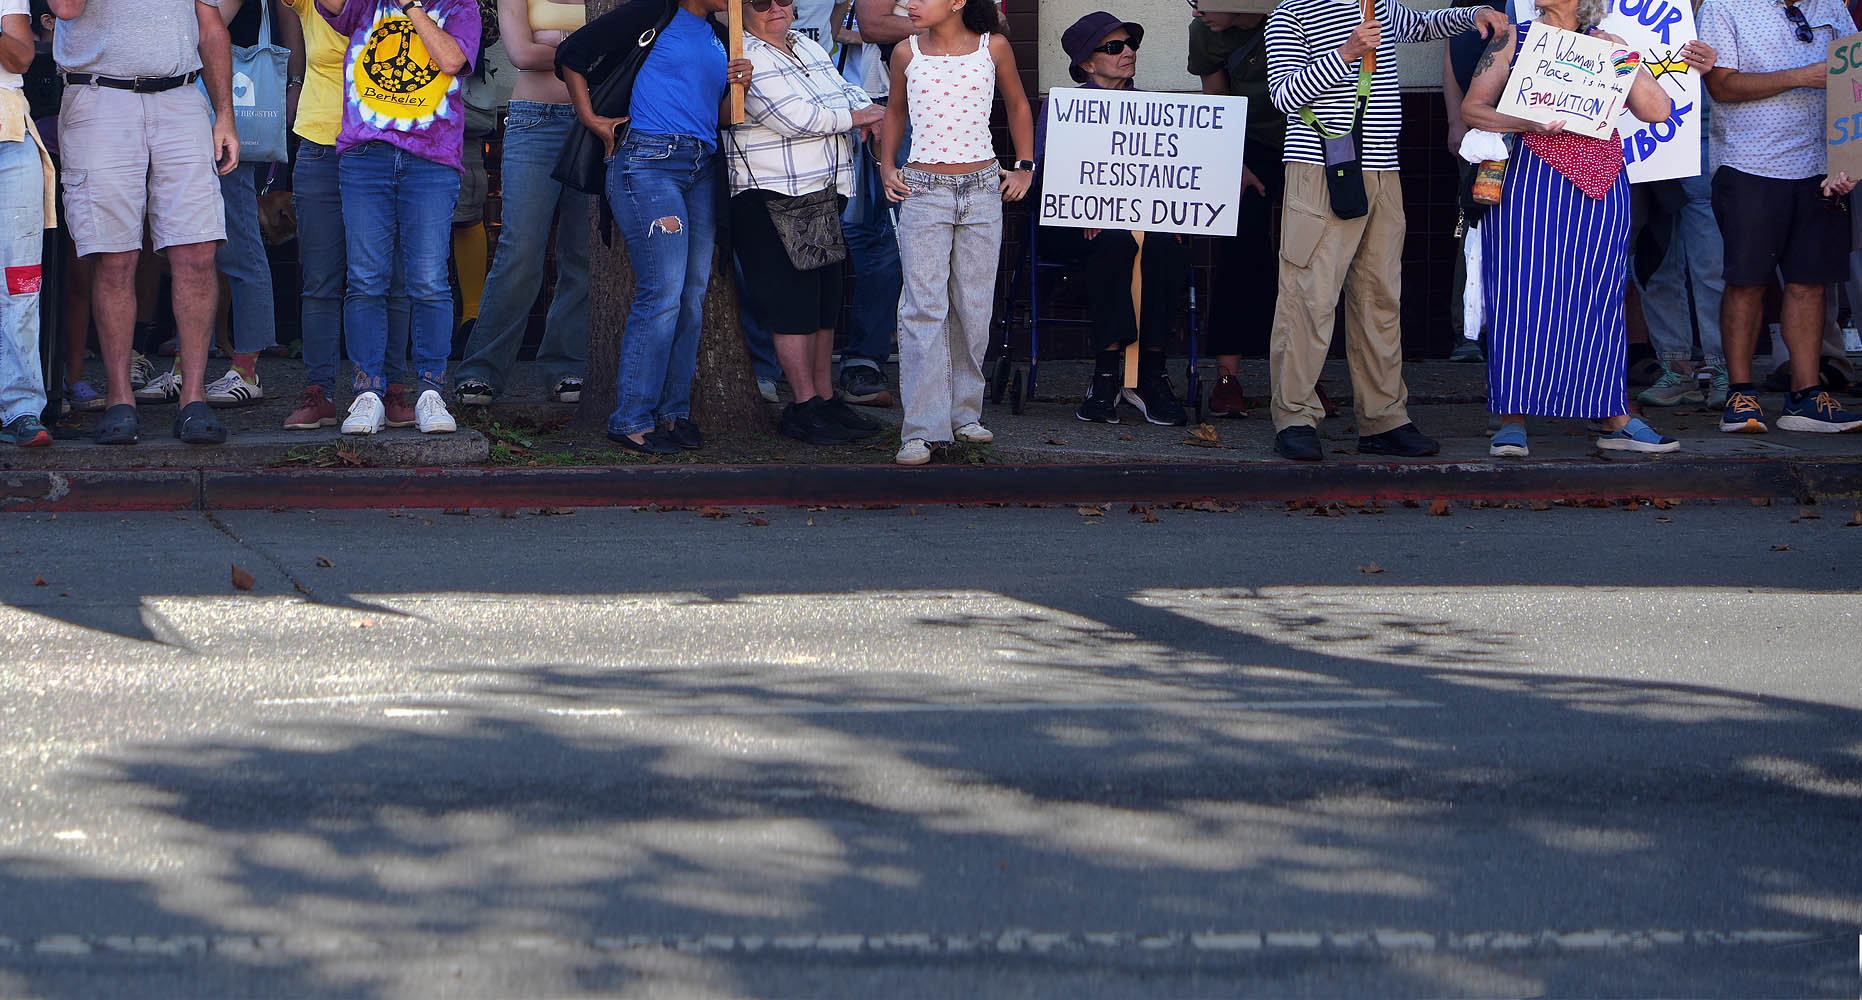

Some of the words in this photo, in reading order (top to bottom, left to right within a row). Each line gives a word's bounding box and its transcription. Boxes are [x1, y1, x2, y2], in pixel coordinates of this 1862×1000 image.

[1533, 31, 1548, 55] A
[1554, 35, 1605, 75] Woman's
[1536, 59, 1573, 83] Place
[1610, 82, 1623, 93] the
[364, 86, 429, 108] Berkeley
[1055, 98, 1110, 124] WHEN
[1119, 101, 1225, 129] INJUSTICE
[1111, 131, 1178, 157] RULES
[1080, 161, 1202, 190] RESISTANCE
[1043, 194, 1142, 222] BECOMES
[1152, 200, 1226, 227] DUTY
